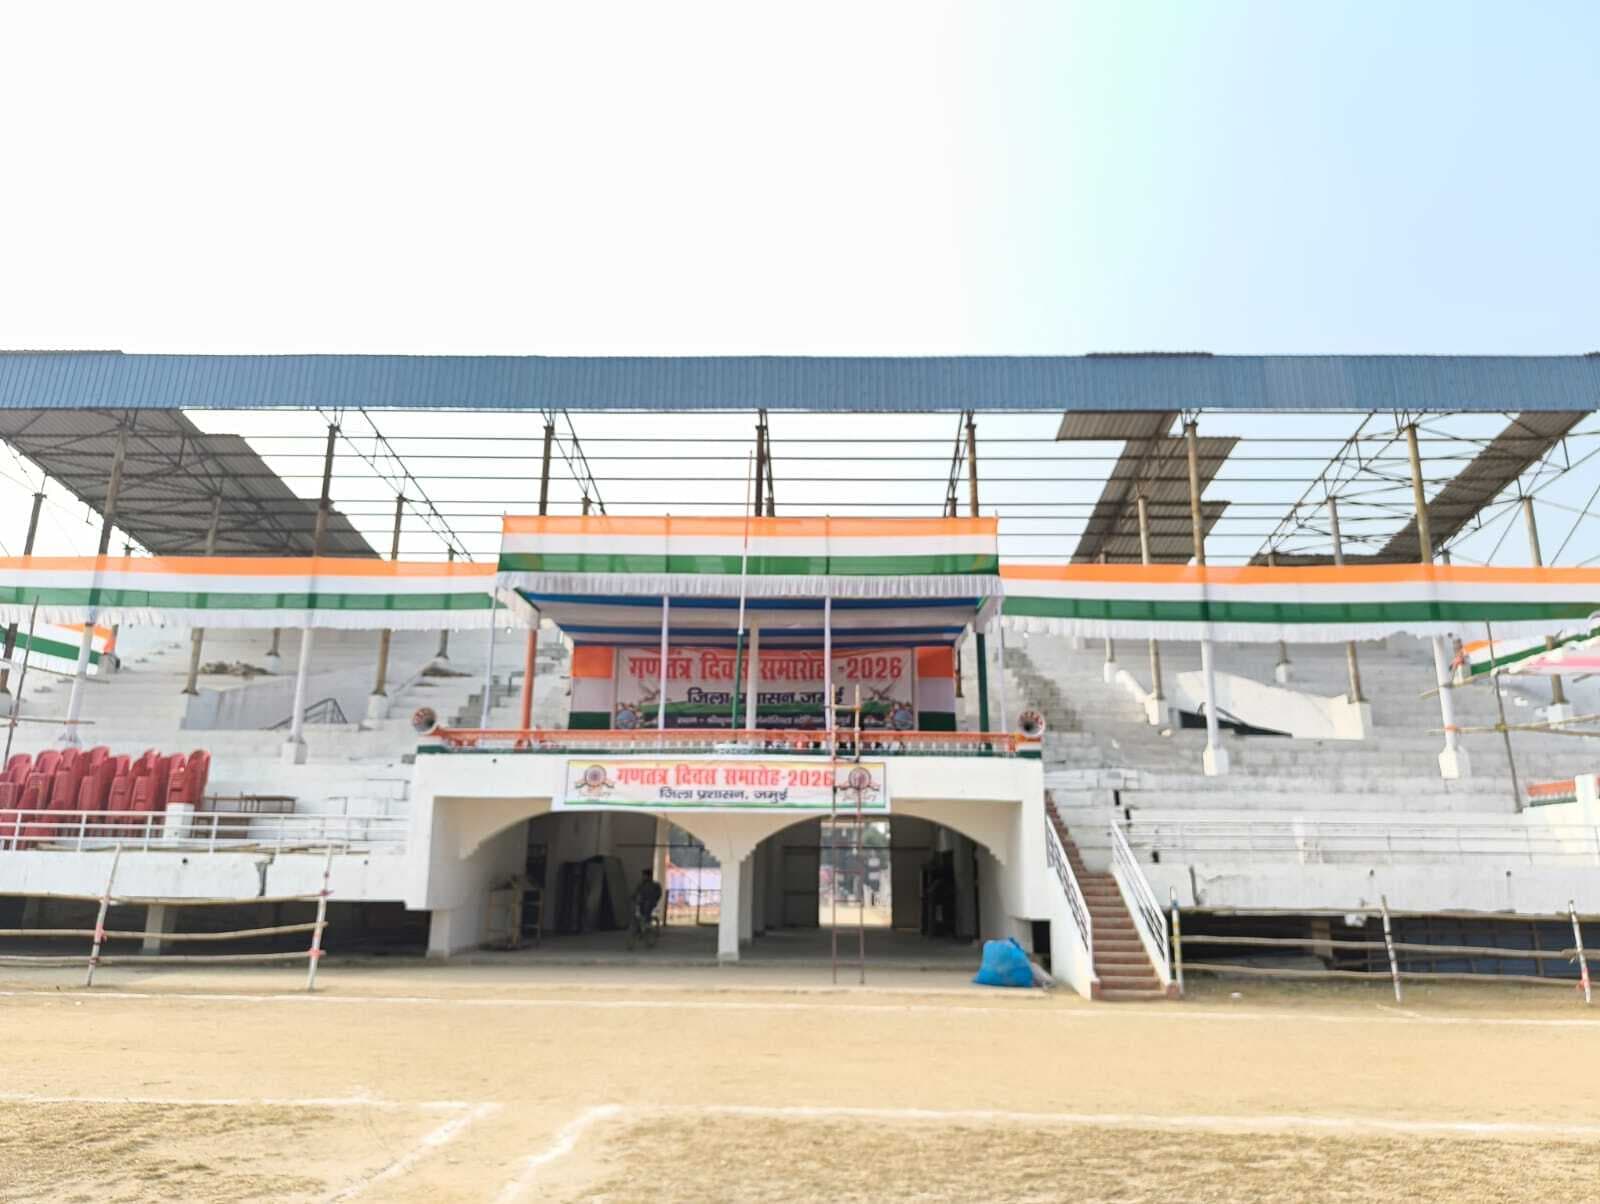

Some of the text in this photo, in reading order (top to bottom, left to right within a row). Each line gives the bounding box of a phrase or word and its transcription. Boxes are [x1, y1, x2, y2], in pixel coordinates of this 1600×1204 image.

[687, 686, 729, 705] जिला
[617, 766, 669, 786] गणतंत्र
[676, 764, 717, 786] दिवस
[659, 786, 693, 799] जिला
[754, 788, 788, 804] जमुई
